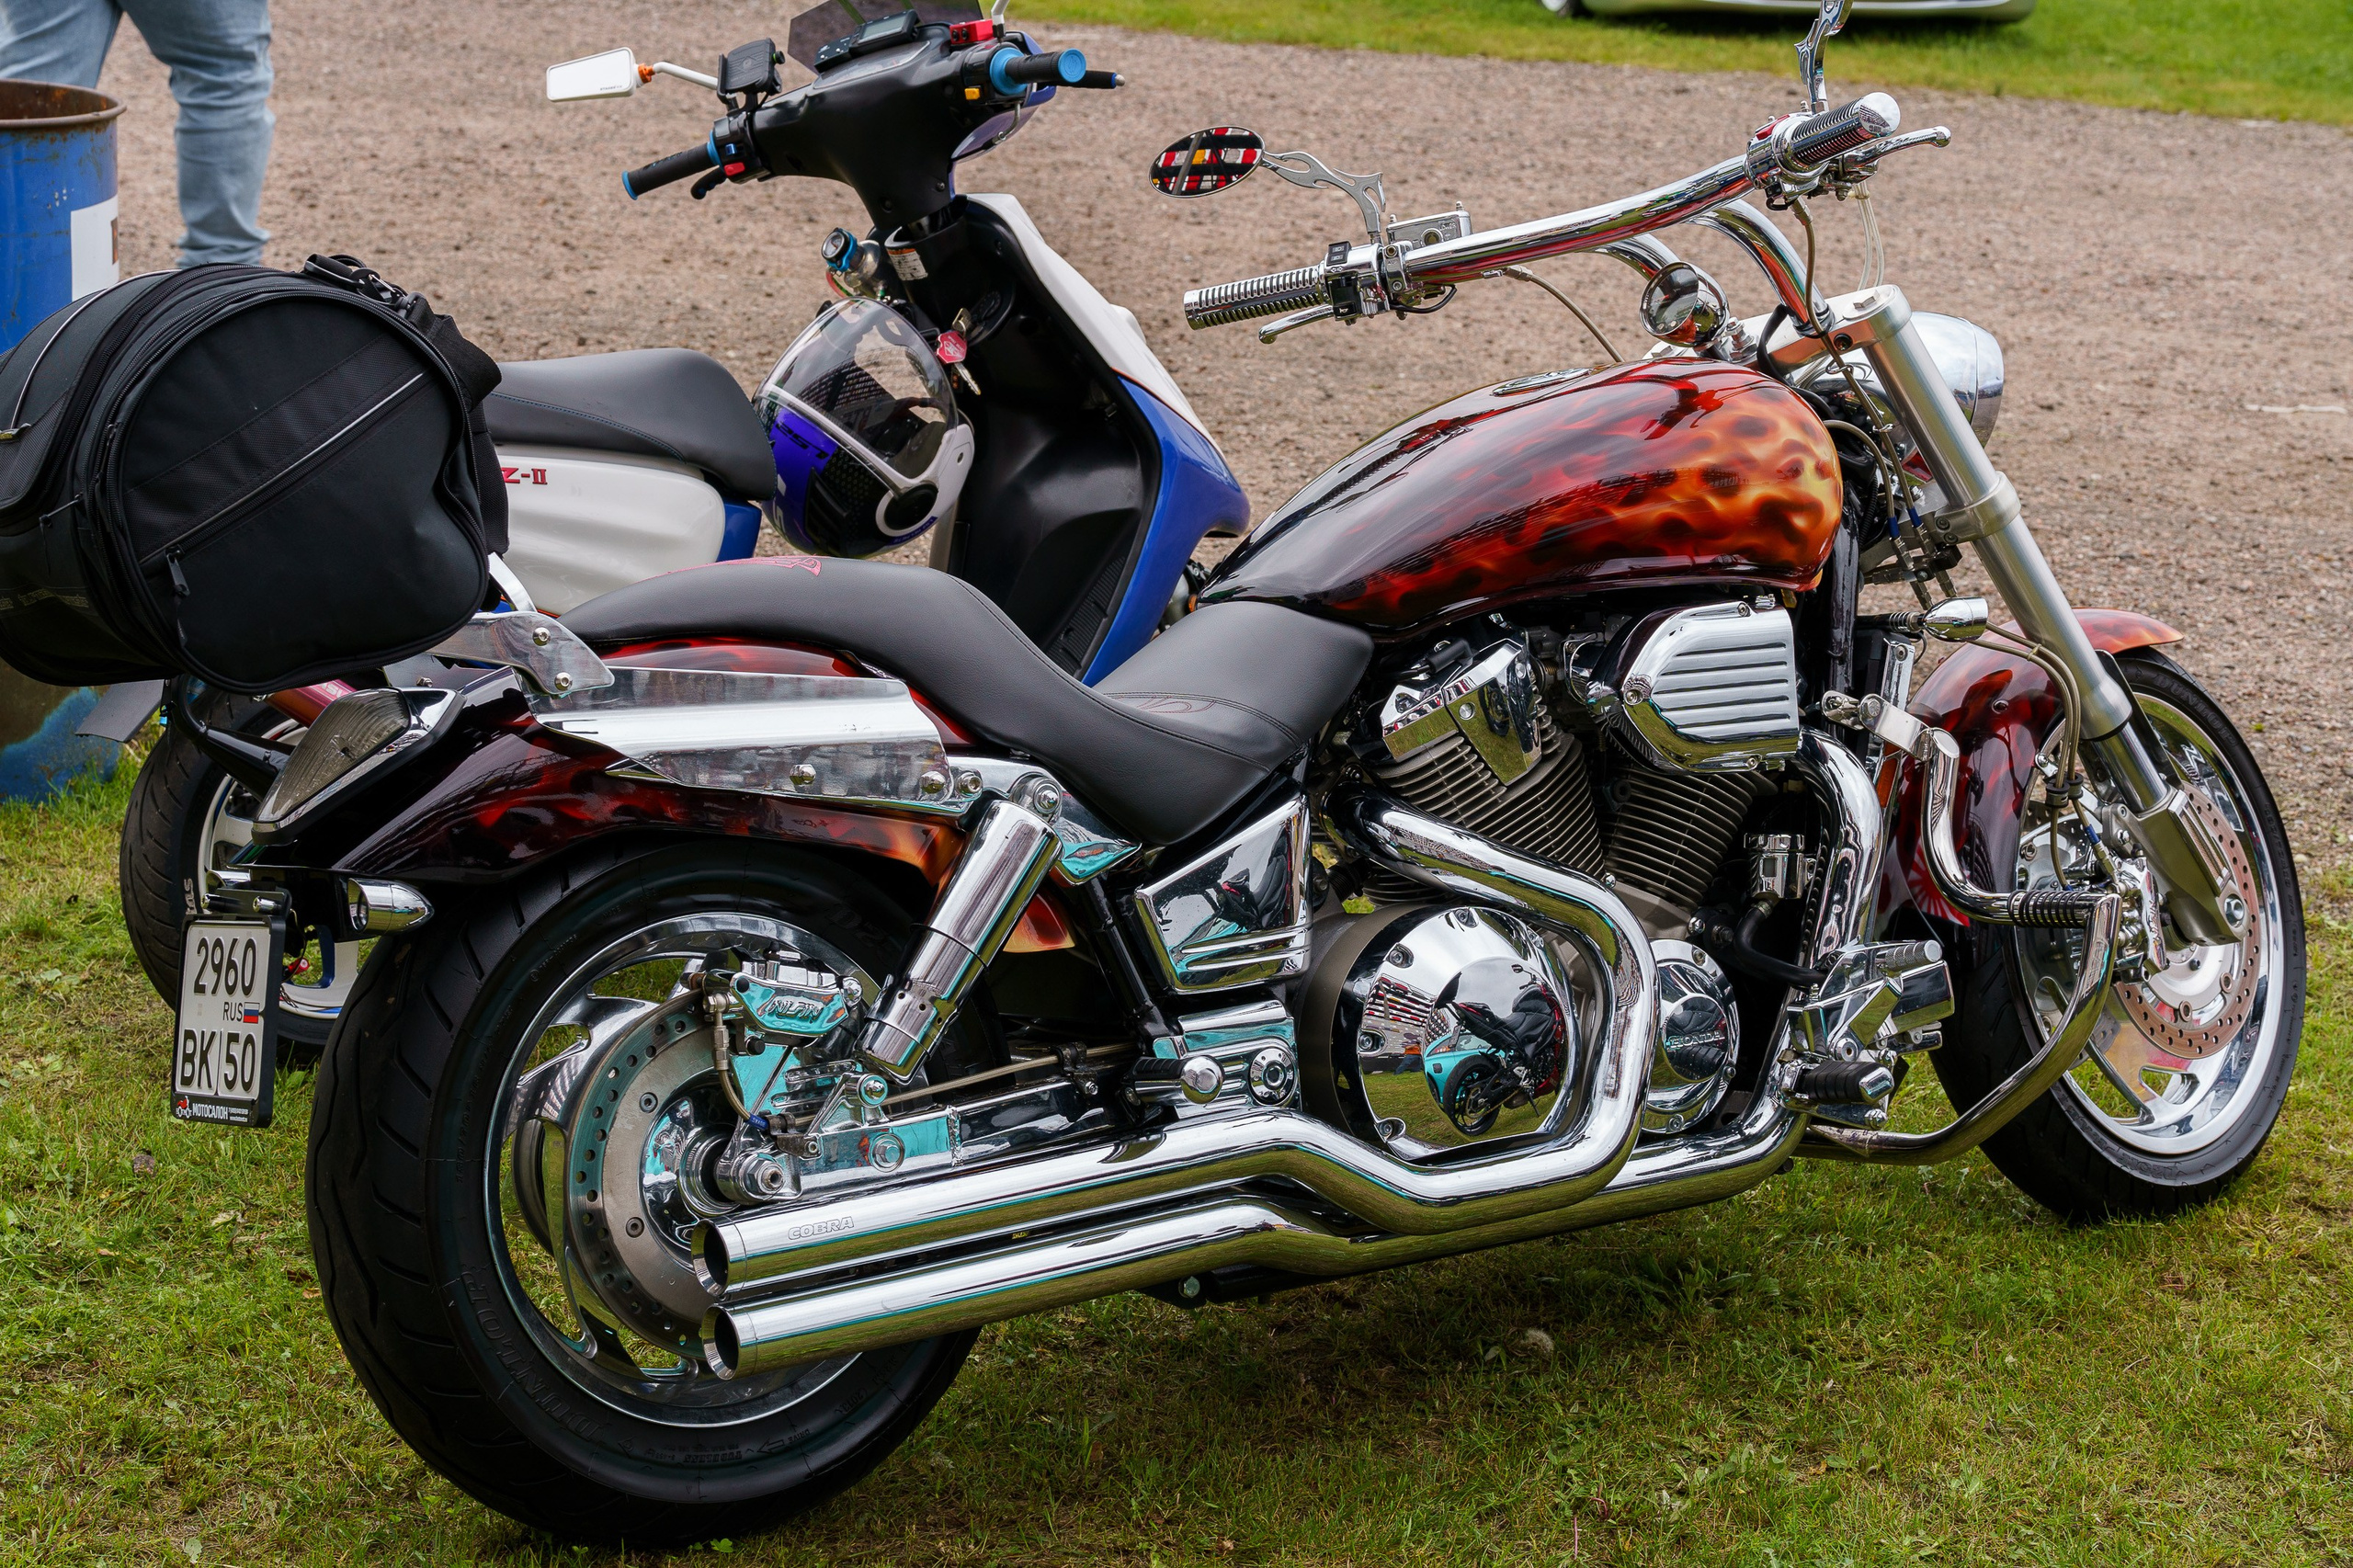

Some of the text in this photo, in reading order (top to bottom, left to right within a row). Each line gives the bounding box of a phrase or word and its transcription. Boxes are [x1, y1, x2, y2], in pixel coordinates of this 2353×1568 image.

[2153, 671, 2239, 748] DUNLOP
[193, 937, 256, 996] 2960
[222, 1001, 244, 1022] RUS
[1667, 1030, 1726, 1050] HONDA
[223, 1031, 256, 1092] 50
[192, 1102, 229, 1120] МОТОСАЛОН
[788, 1215, 855, 1241] COBRA
[460, 1267, 603, 1443] DUNLOP
